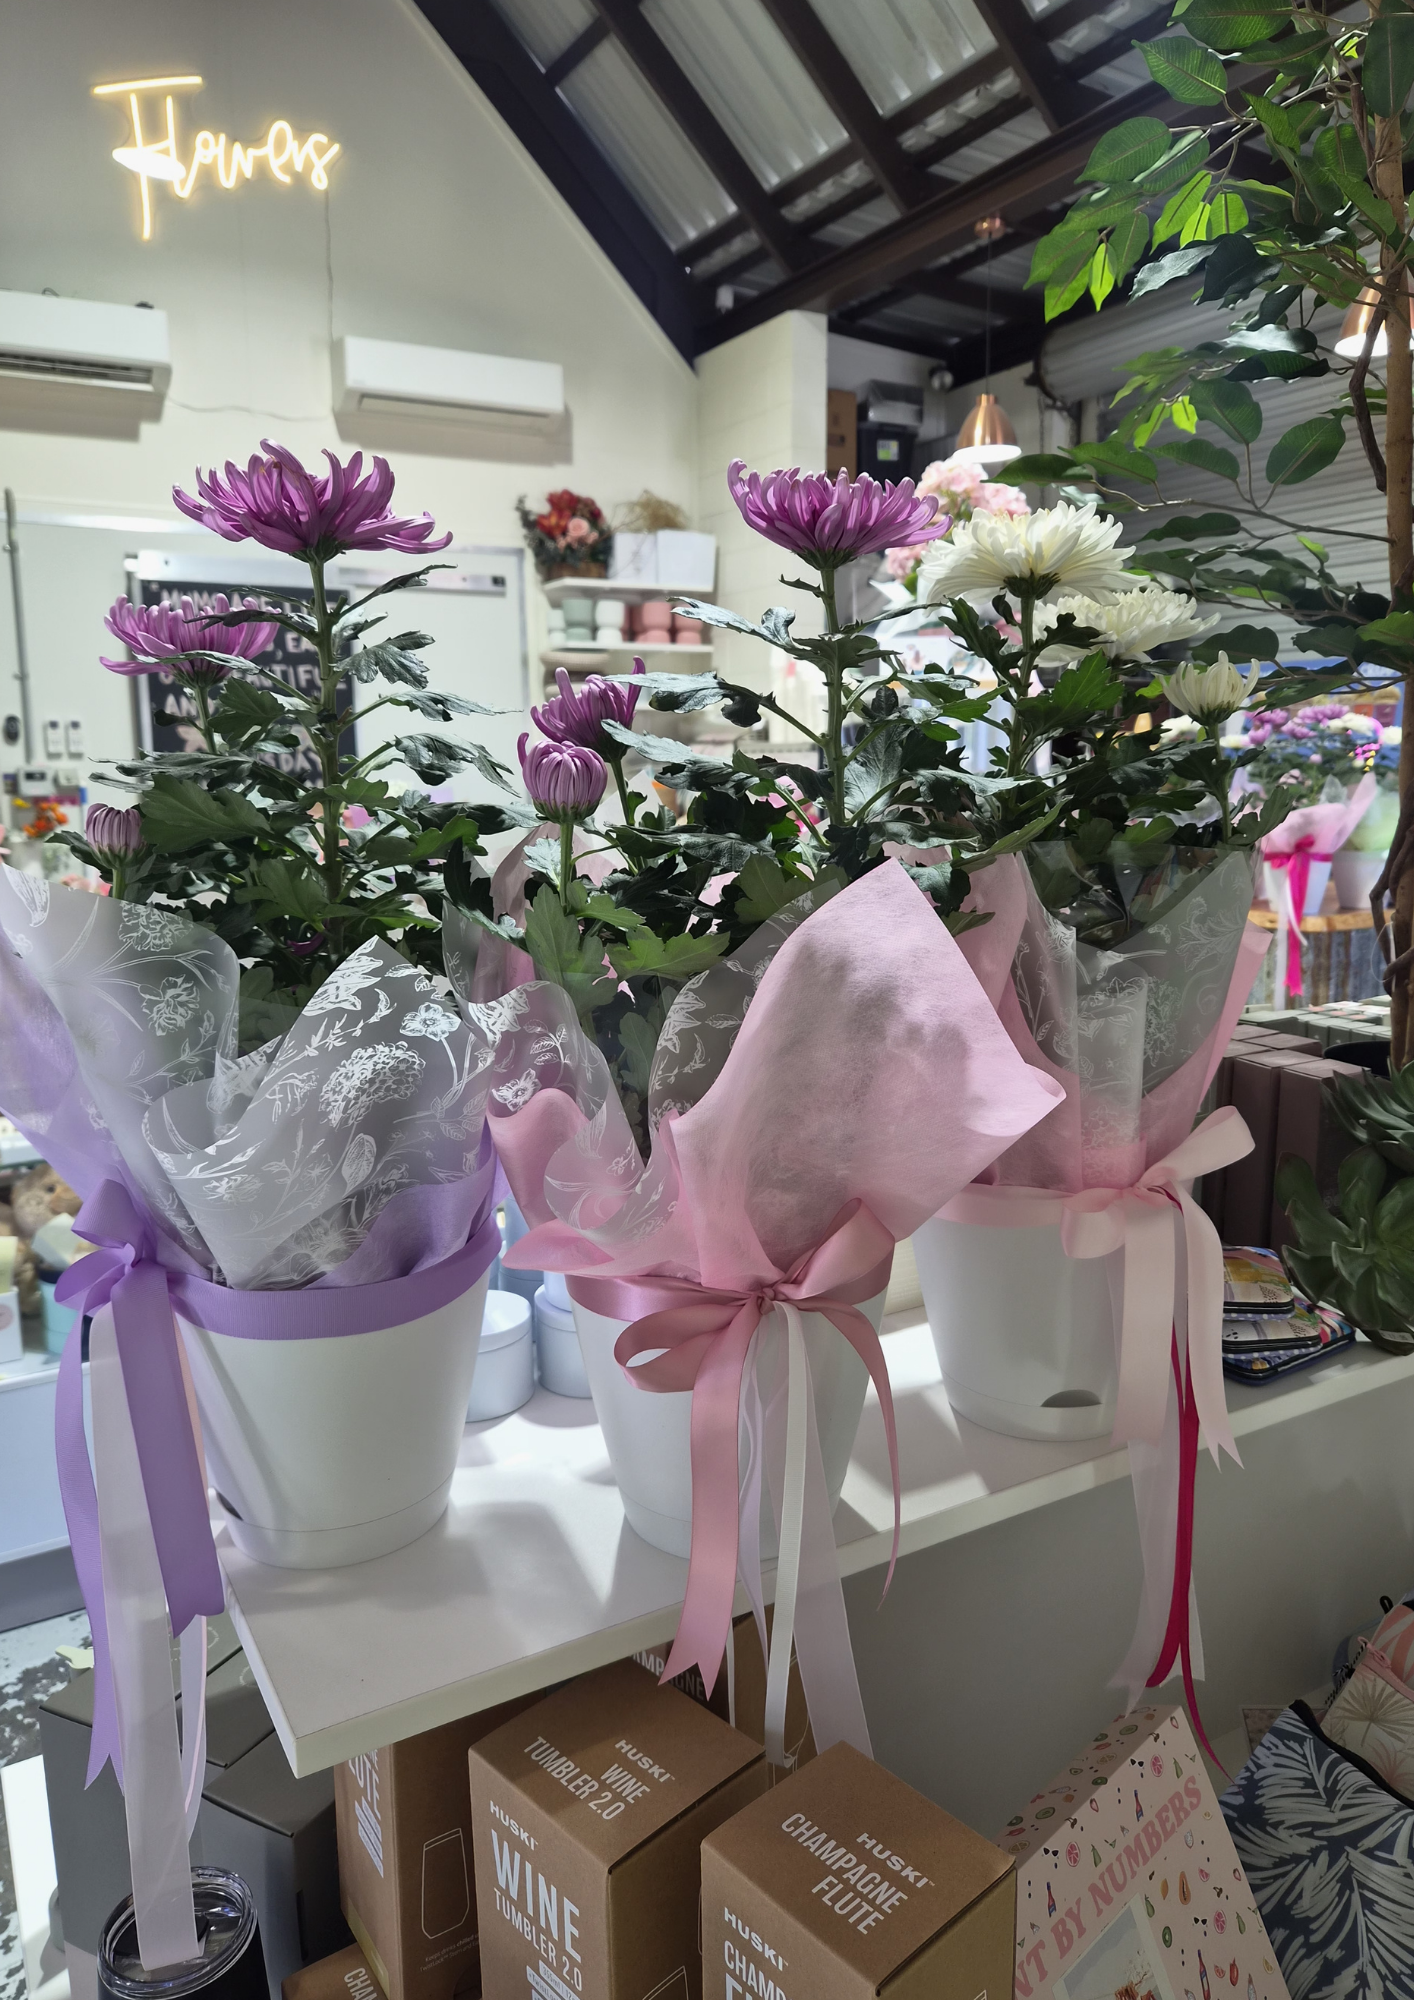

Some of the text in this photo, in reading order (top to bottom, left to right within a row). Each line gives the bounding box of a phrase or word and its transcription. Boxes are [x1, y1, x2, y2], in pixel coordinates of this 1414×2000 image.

[93, 75, 341, 241] Flowers
[523, 1736, 626, 1820] TUMBLER 2.0
[600, 1763, 651, 1804] WINE
[614, 1739, 672, 1783] HUSKI
[490, 1800, 537, 1851] HUSKI
[856, 1832, 930, 1888] HUSKI
[491, 1829, 582, 1964] WINE
[781, 1813, 909, 1914] CHAMPAGNE
[1051, 1897, 1087, 1960] BY
[1088, 1775, 1202, 1917] NUMBERS
[494, 1887, 583, 1992] TUMBLER 2.0
[724, 1906, 783, 1972] HUSKI
[811, 1875, 885, 1935] FLUTE
